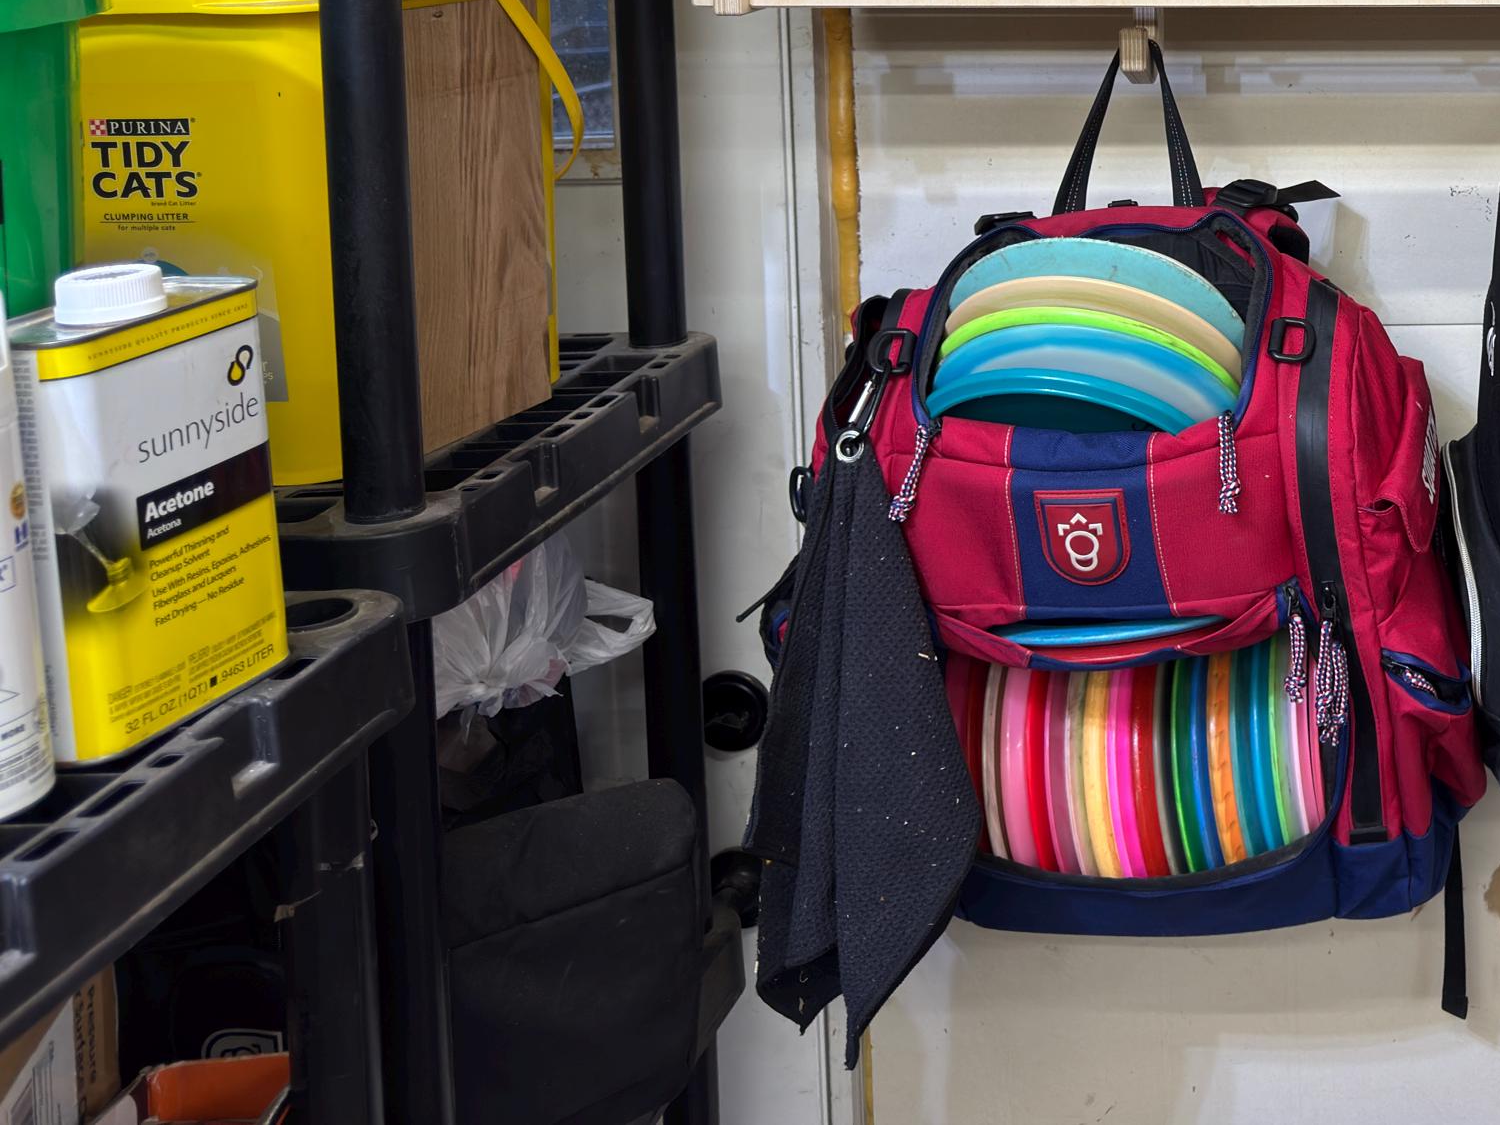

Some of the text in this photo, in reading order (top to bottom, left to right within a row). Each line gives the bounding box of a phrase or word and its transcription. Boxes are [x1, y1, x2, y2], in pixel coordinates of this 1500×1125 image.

[110, 120, 187, 135] PURINA
[91, 141, 191, 168] TIDY
[92, 172, 198, 199] CATS
[103, 213, 188, 221] CLUMPING LITTER
[131, 224, 159, 232] multiple
[138, 392, 259, 463] sunnyside
[145, 481, 215, 523] Acetone
[147, 518, 182, 539] Acetona
[149, 525, 230, 569] Powerful Thinning and
[150, 549, 210, 581] Cleanup Solvent
[152, 586, 167, 597] Use
[168, 578, 185, 591] With
[153, 566, 237, 611] Fiberglass and Lacquers
[155, 577, 245, 627] Fast Drying No Residue
[125, 718, 140, 734] 32
[246, 644, 274, 668] LITER
